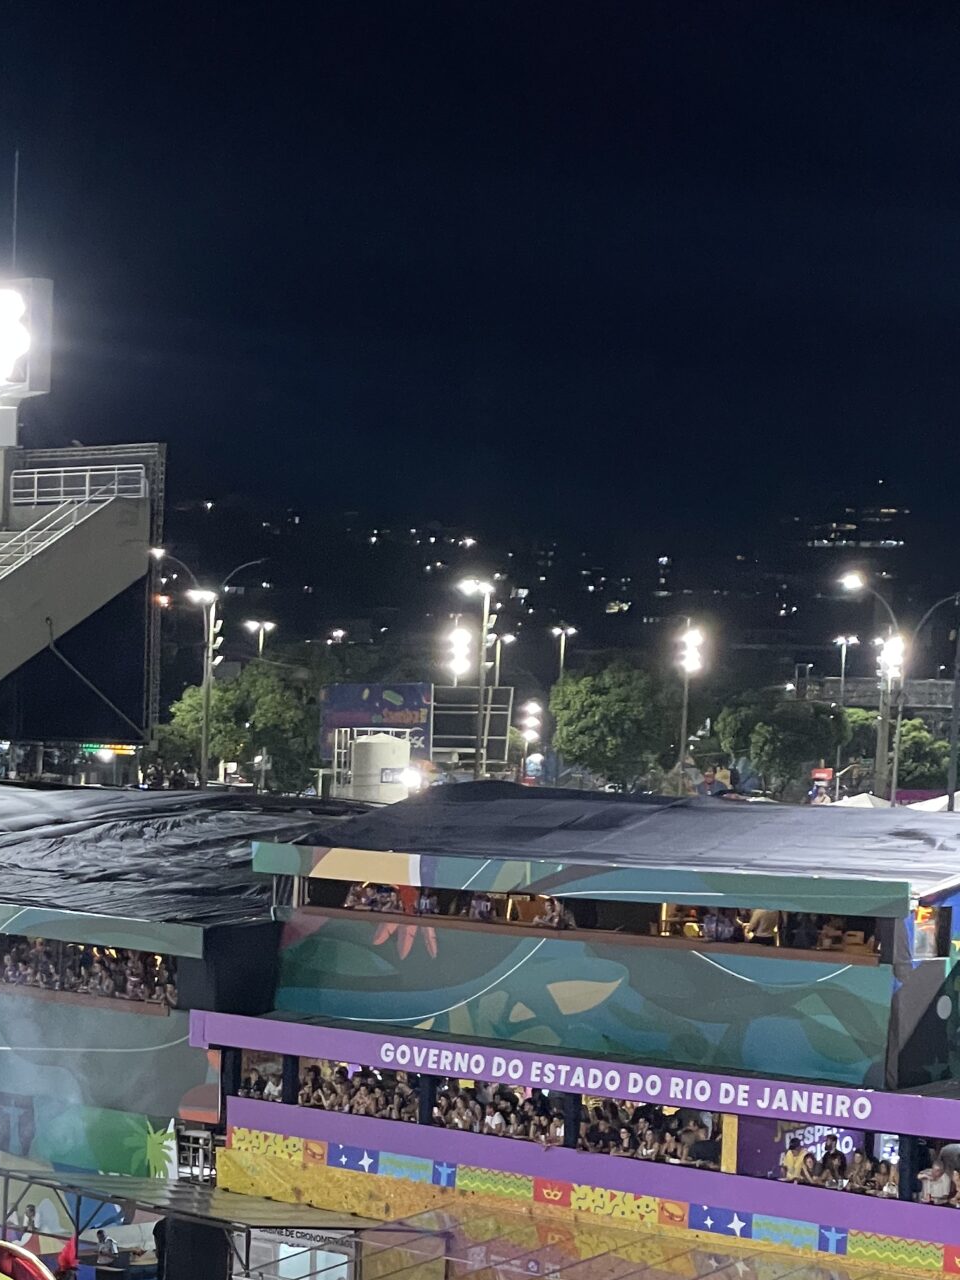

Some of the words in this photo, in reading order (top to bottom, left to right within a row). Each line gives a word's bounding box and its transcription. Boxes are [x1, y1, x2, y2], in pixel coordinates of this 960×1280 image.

[380, 1042, 485, 1075] GOVERNO
[491, 1056, 524, 1080] DO
[530, 1061, 621, 1091] ESTADO
[627, 1072, 662, 1096] DO
[669, 1077, 712, 1102] RIO
[719, 1082, 750, 1107] DE
[756, 1087, 872, 1120] JANEIRO
